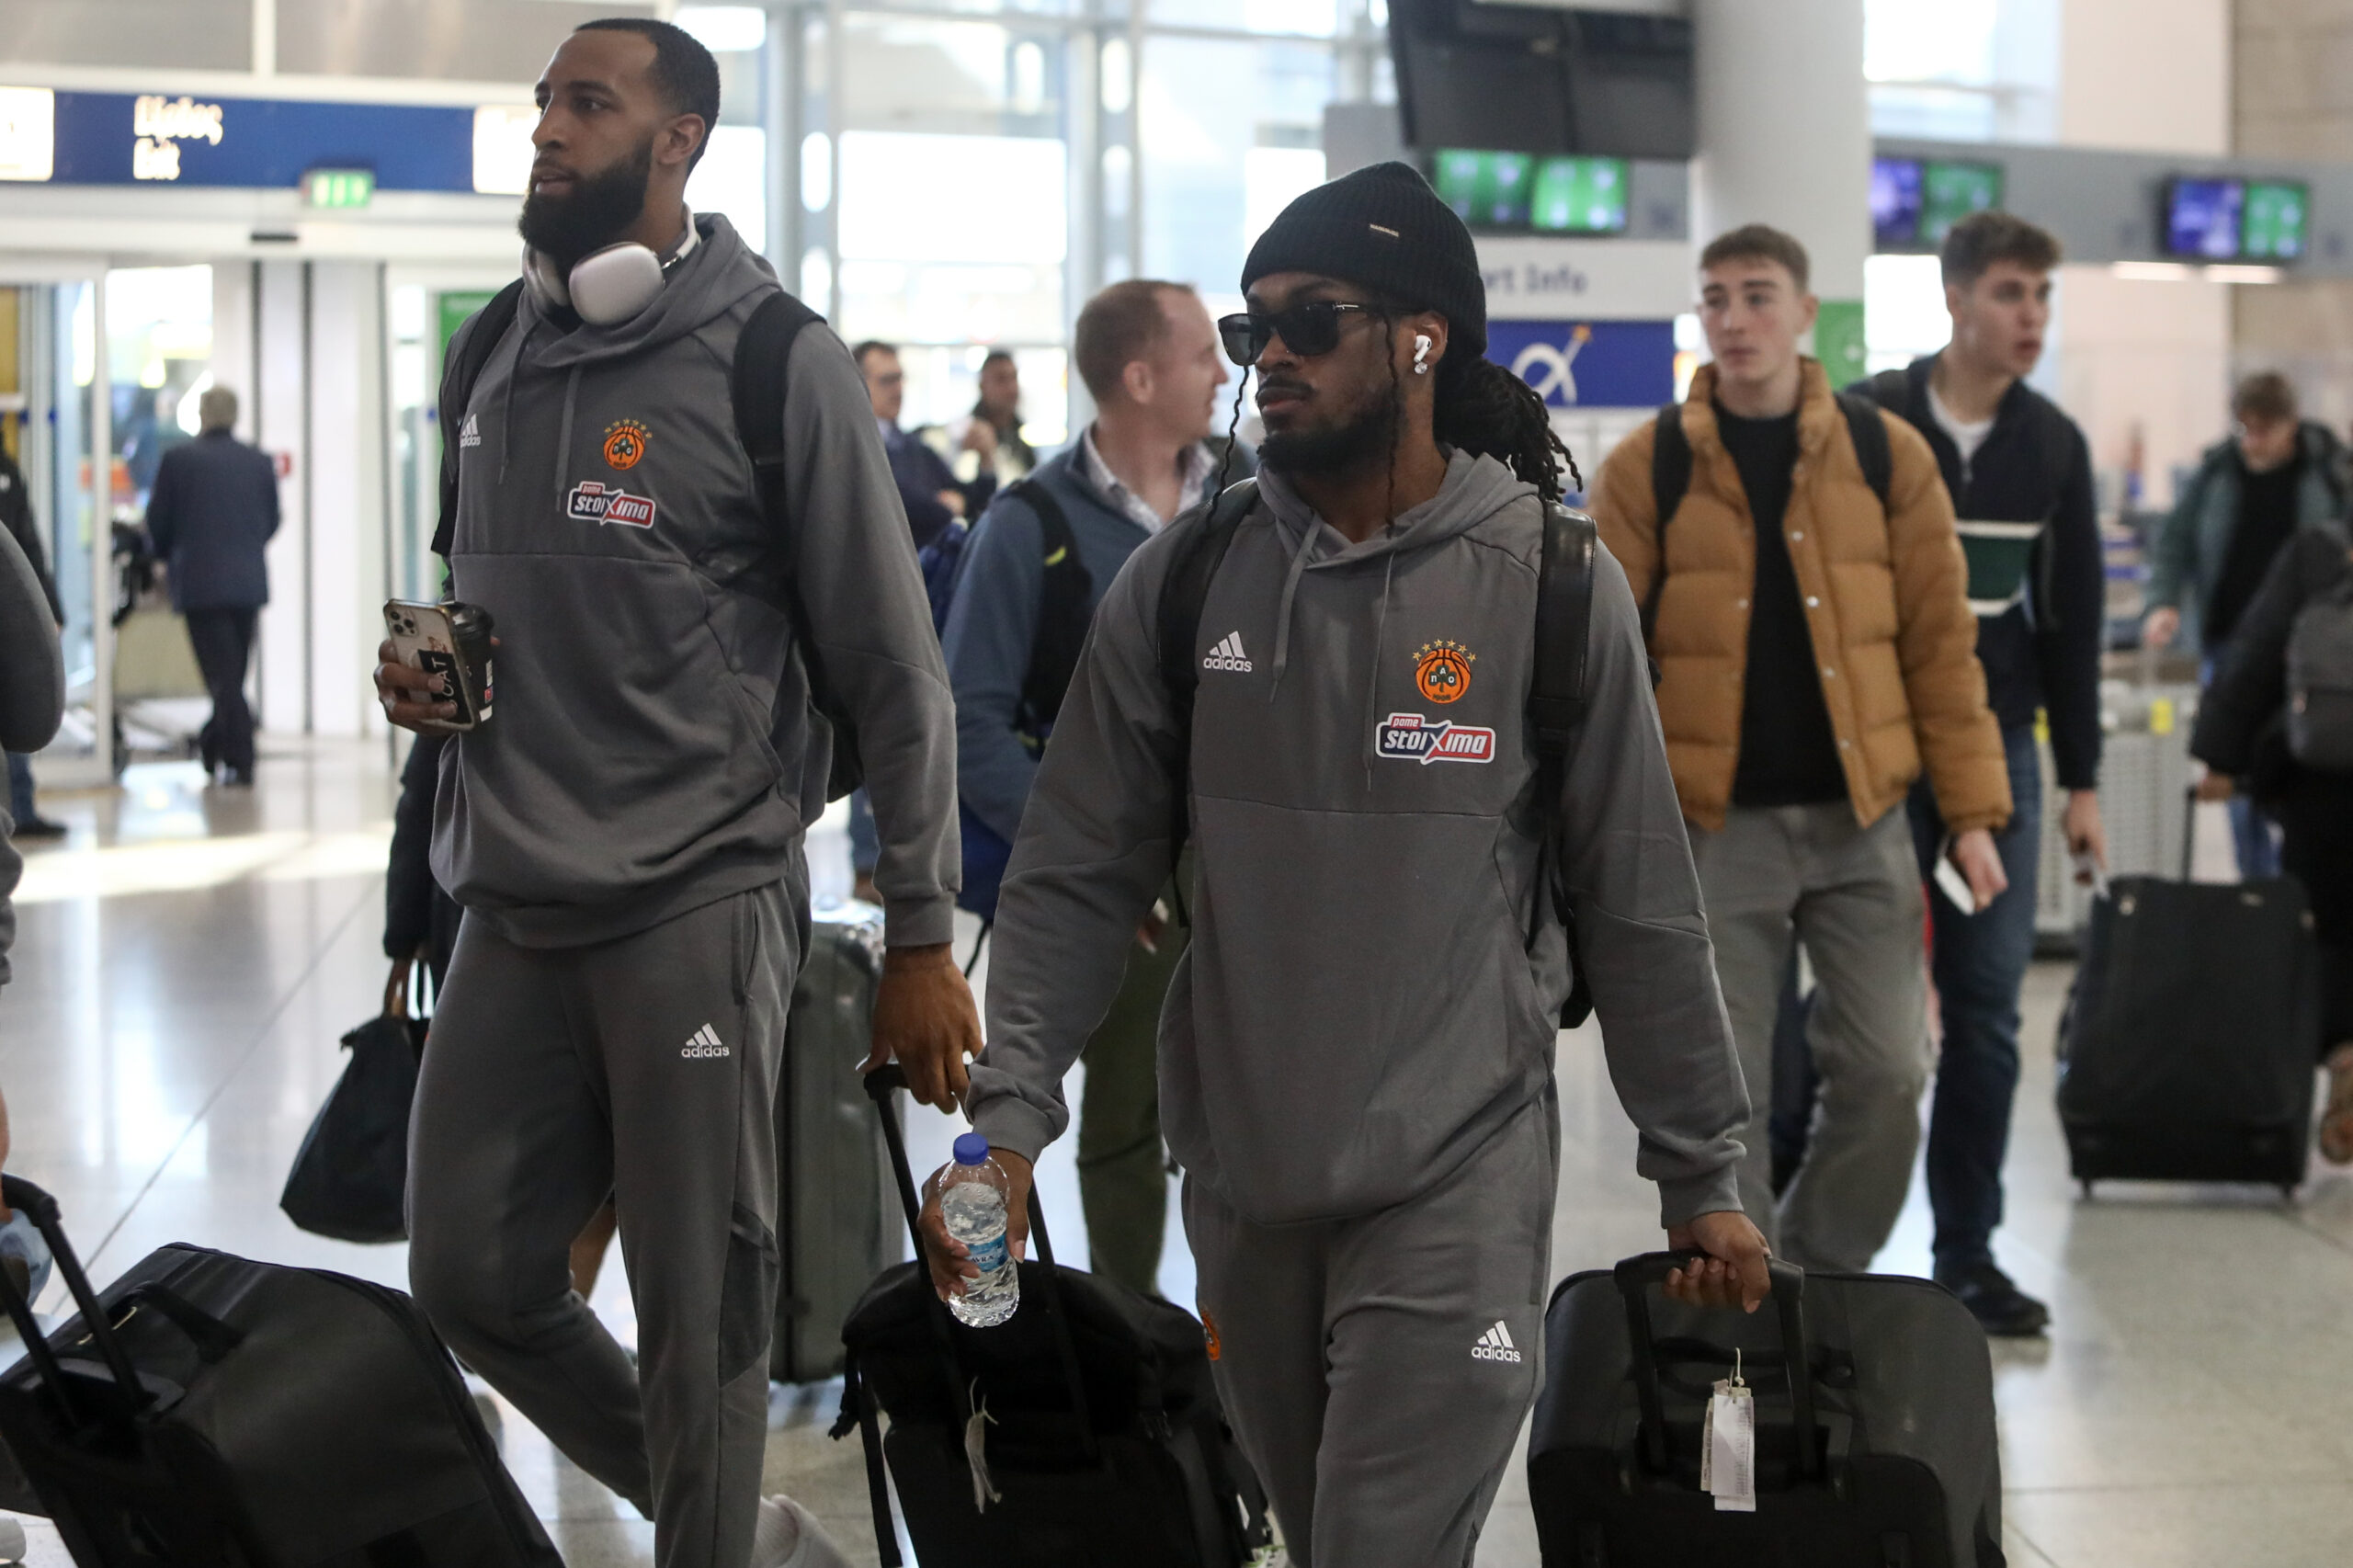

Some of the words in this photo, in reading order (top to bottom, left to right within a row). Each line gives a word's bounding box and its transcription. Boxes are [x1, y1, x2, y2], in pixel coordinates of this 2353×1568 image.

[1203, 654, 1253, 673] adidas
[1392, 717, 1419, 728] pame
[681, 1043, 730, 1058] adidas
[1471, 1345, 1521, 1362] adidas
